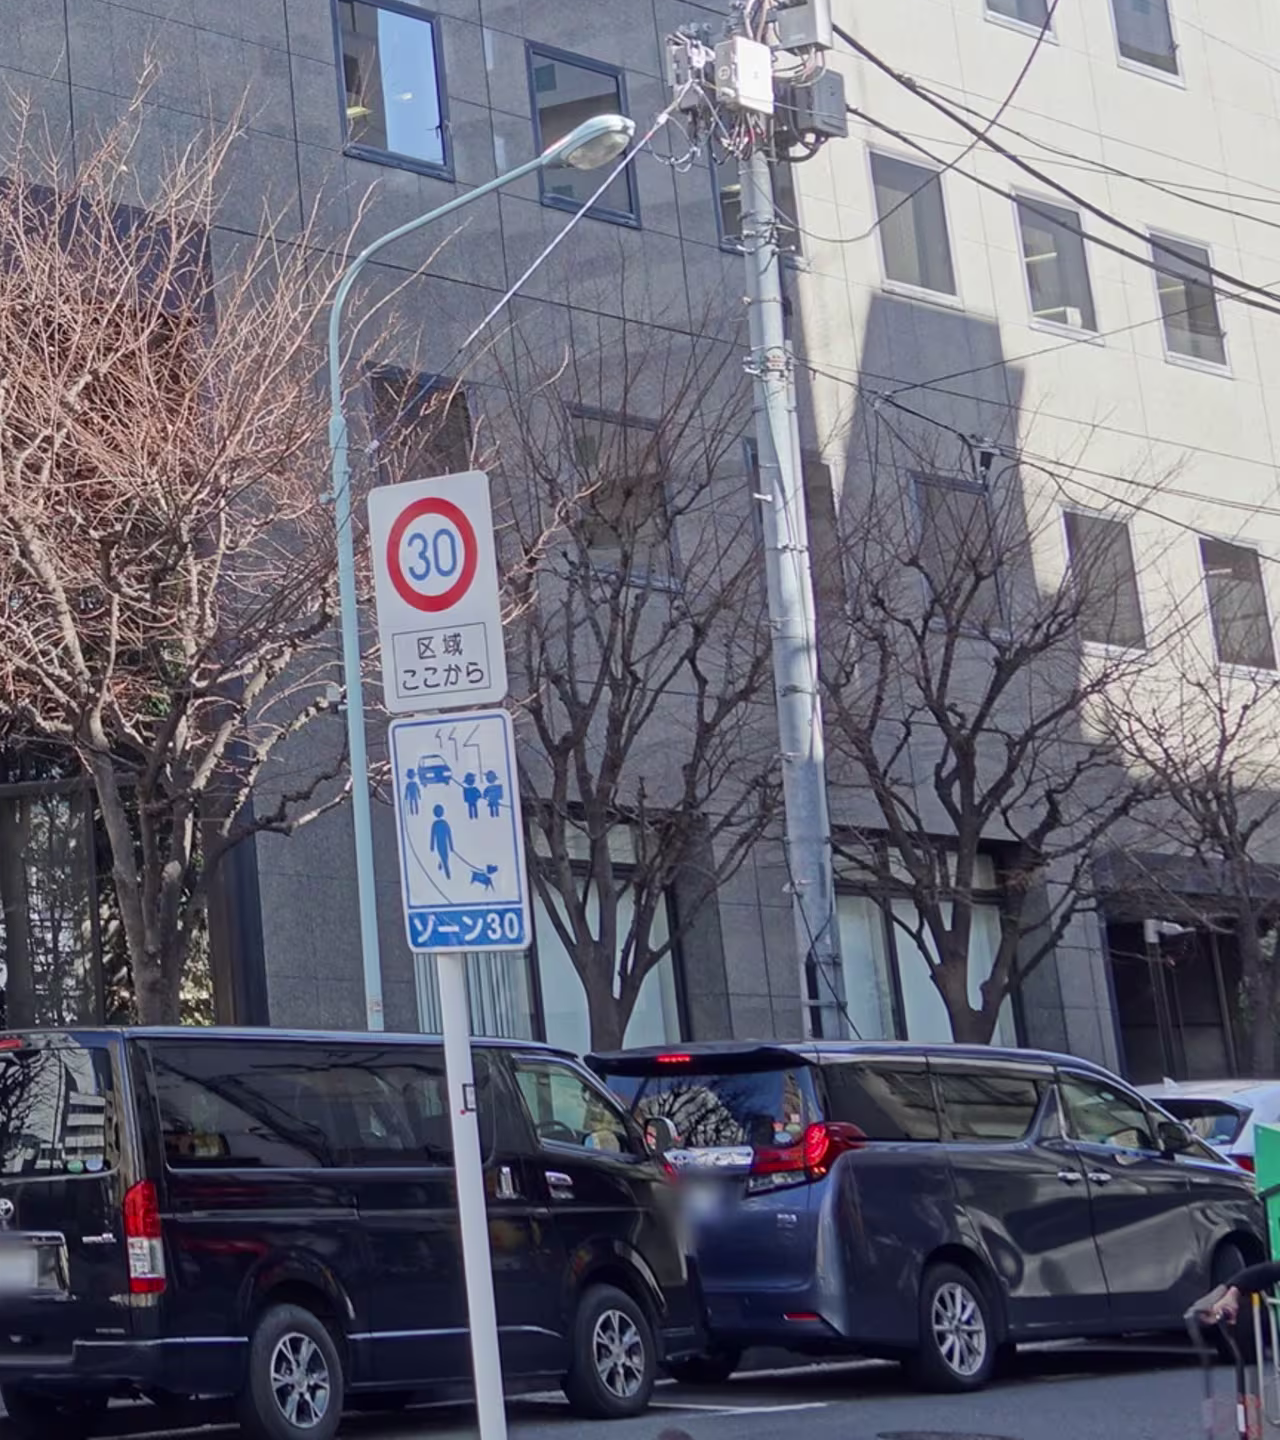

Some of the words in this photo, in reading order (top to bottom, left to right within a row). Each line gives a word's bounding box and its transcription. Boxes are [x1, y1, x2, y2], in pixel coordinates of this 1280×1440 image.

[407, 528, 458, 581] 30
[416, 632, 464, 660] 区域
[401, 661, 485, 691] ここから
